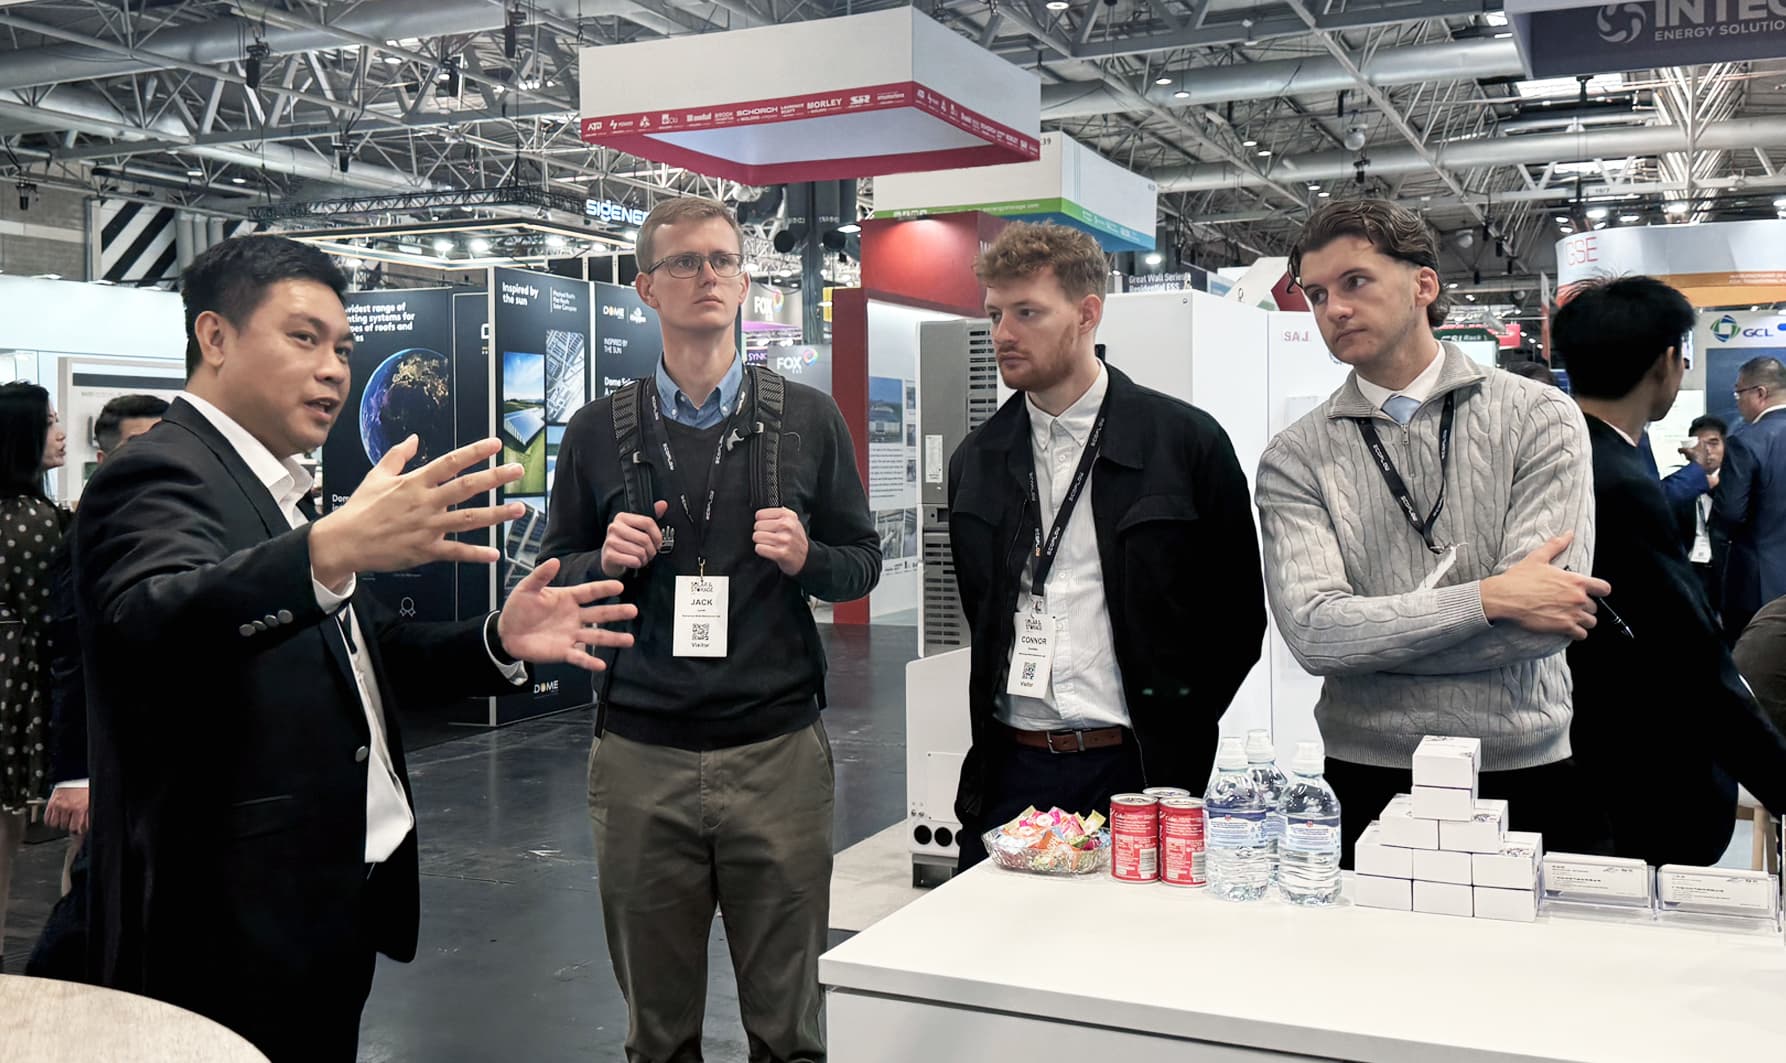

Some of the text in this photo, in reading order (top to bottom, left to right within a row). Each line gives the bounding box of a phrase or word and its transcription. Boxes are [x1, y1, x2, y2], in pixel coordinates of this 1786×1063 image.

[1655, 20, 1786, 41] ENERGY SOLUTIO
[807, 98, 842, 109] MORLEY
[1129, 275, 1146, 284] Great
[1148, 273, 1163, 282] Wall
[502, 282, 540, 298] Inspired by
[502, 294, 528, 306] the sun
[754, 296, 772, 314] FOX
[372, 304, 395, 315] range
[396, 302, 406, 312] of
[369, 313, 401, 324] systems
[402, 312, 416, 321] for
[364, 324, 374, 332] of
[375, 322, 396, 332] roofs
[396, 322, 413, 331] and
[1743, 328, 1774, 338] GCL
[1284, 330, 1308, 342] SAJ
[777, 356, 802, 370] FOX
[604, 376, 621, 386] Dome
[1021, 636, 1047, 645] CONNOR
